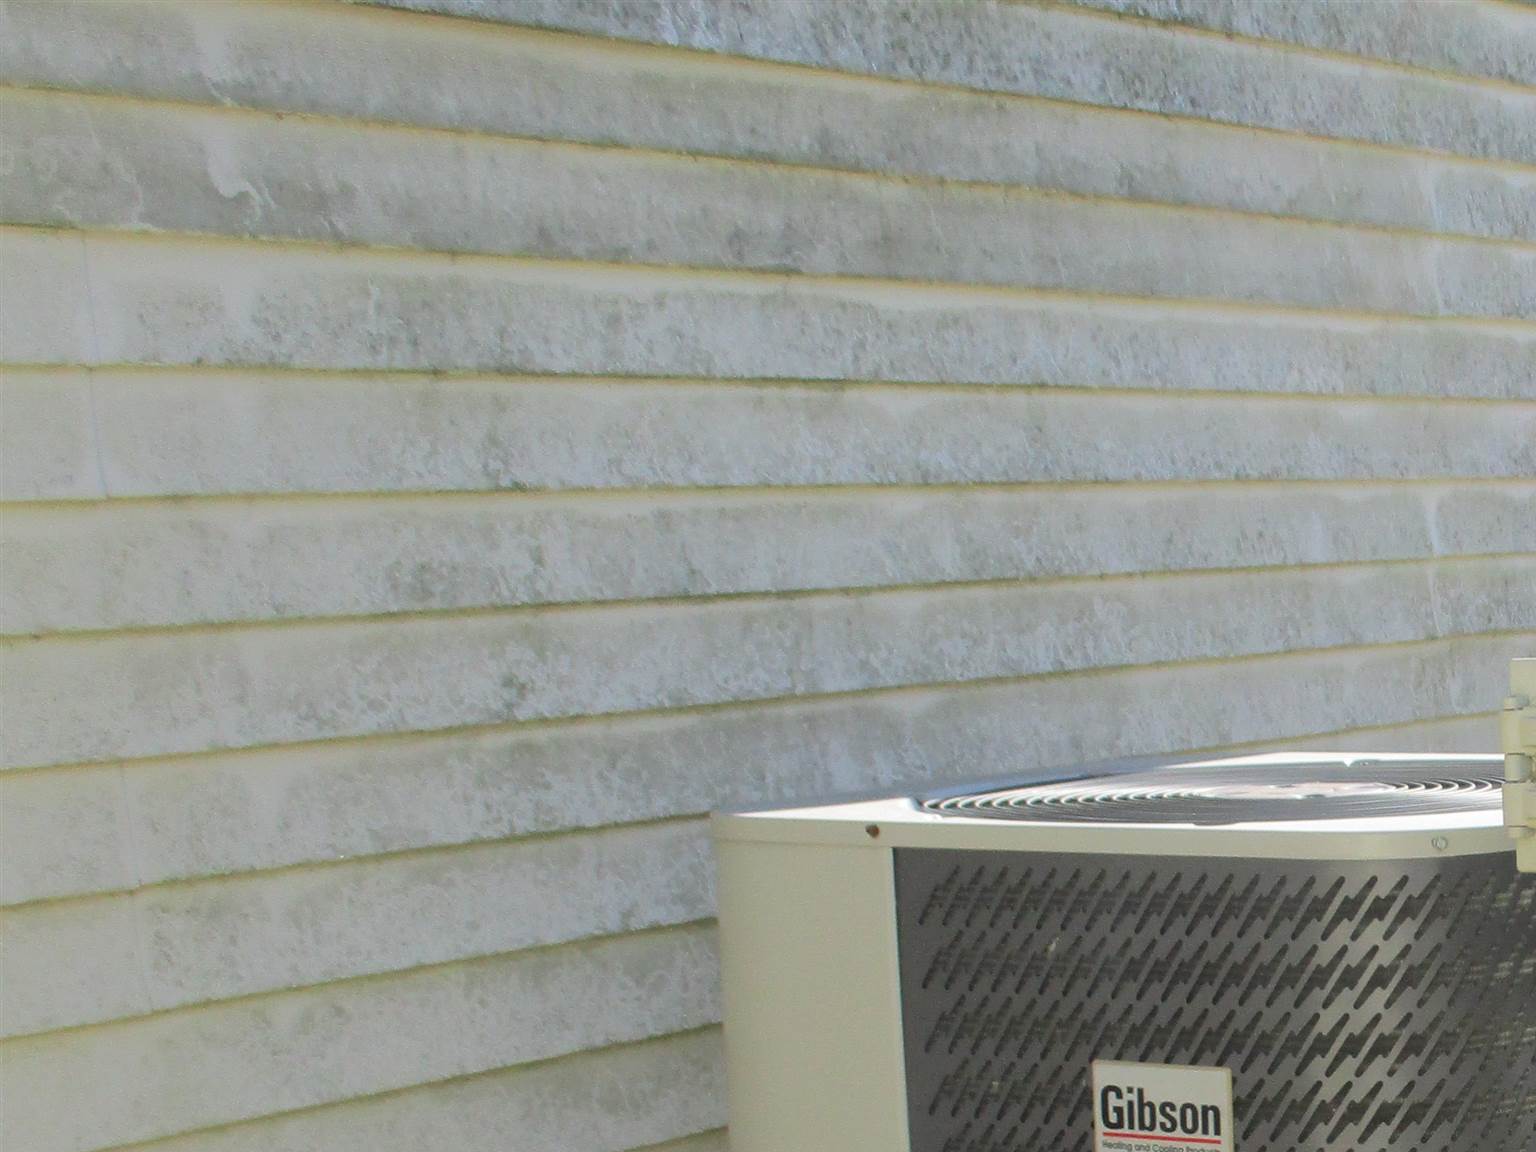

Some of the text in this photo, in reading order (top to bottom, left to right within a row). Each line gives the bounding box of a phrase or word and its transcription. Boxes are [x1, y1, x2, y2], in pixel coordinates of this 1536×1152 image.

[1101, 1085, 1221, 1136] Gibson
[1102, 1141, 1132, 1152] Heating
[1134, 1144, 1150, 1152] and
